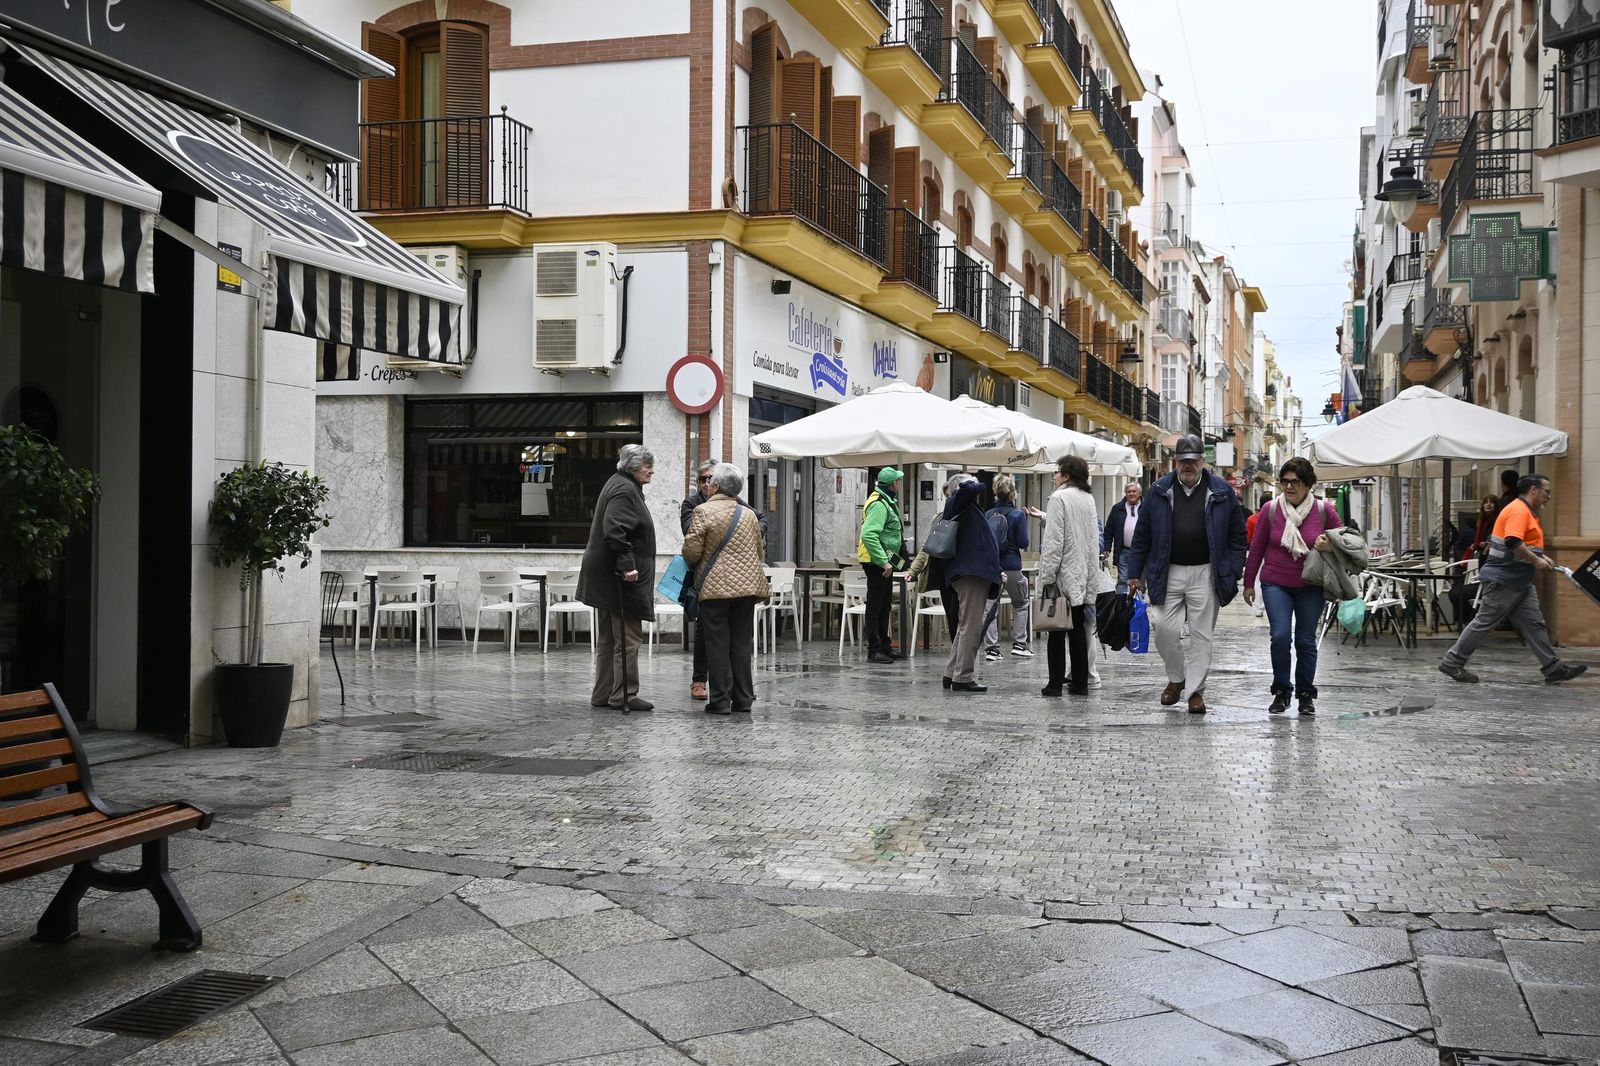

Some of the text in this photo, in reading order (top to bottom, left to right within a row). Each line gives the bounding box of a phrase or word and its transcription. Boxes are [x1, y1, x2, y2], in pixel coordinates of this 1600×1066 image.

[788, 302, 833, 357] Cafetería
[752, 350, 800, 380] Comida para llevar
